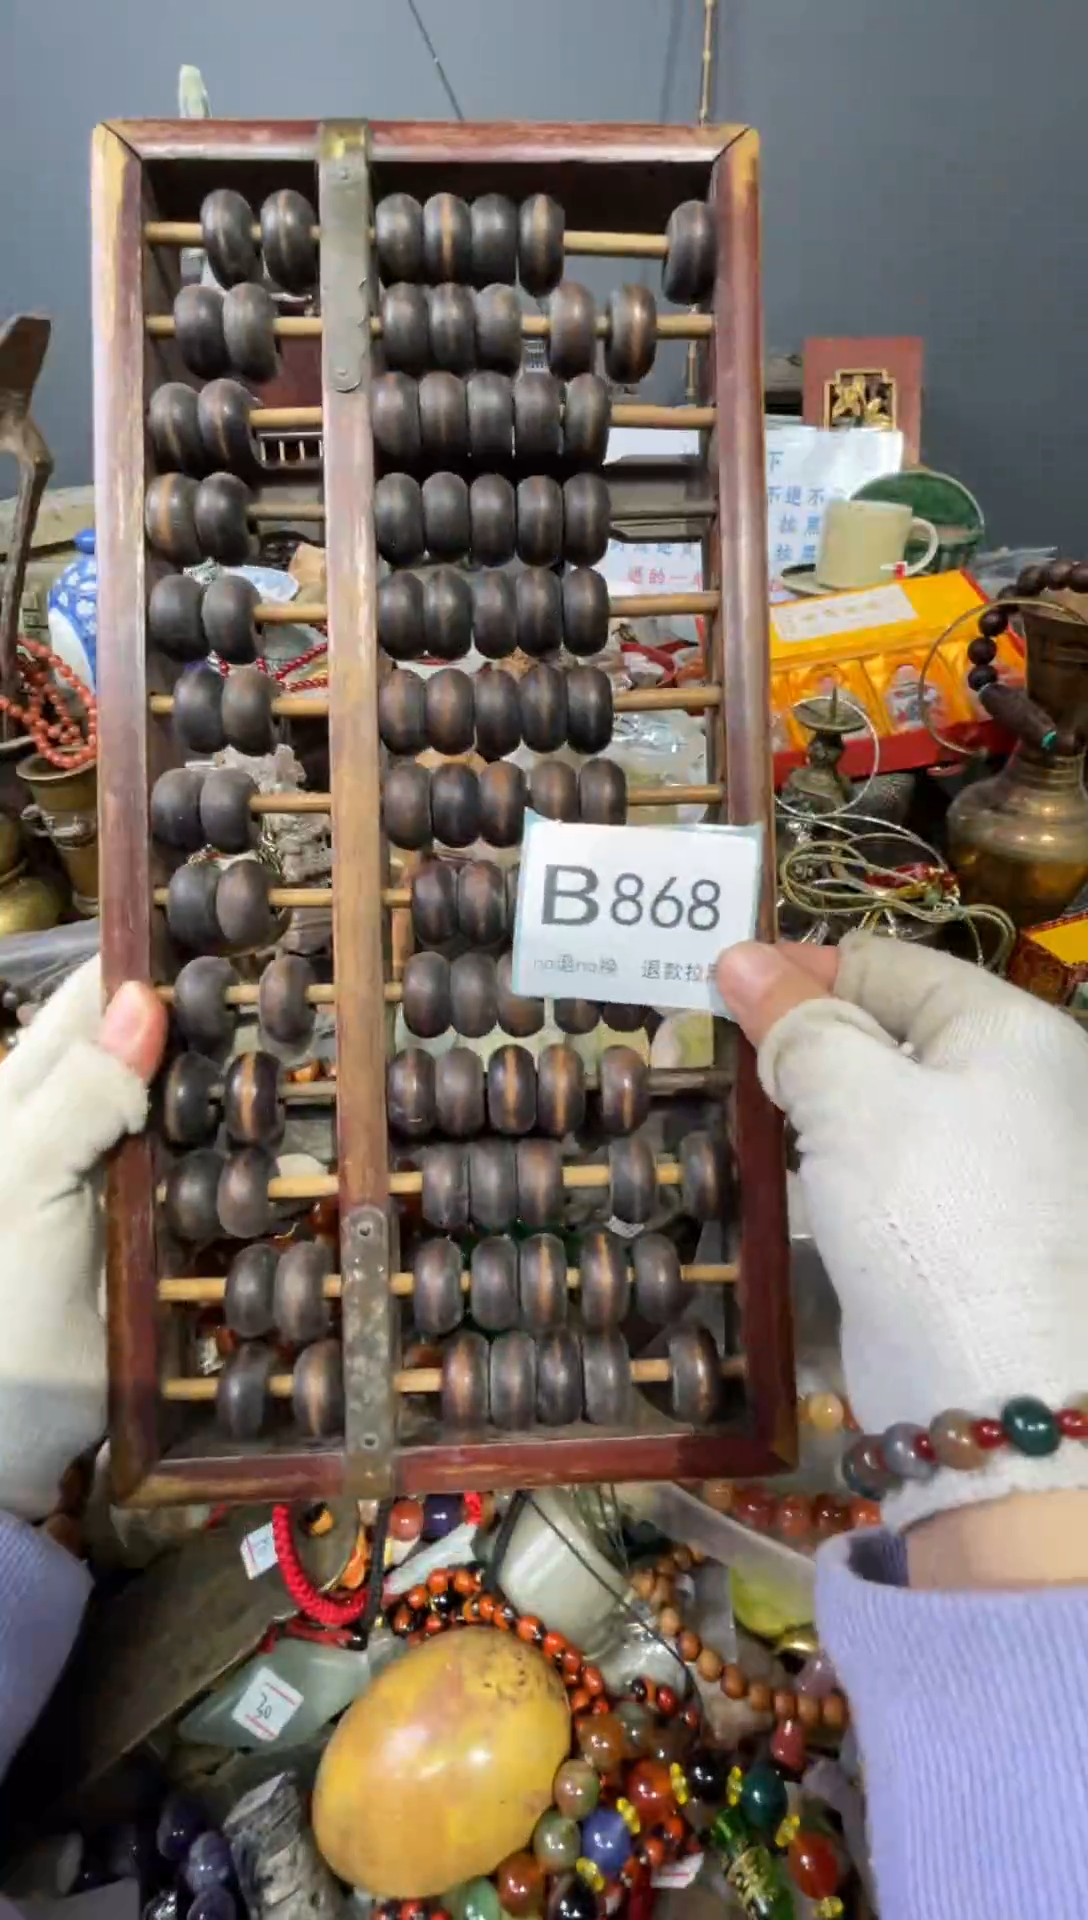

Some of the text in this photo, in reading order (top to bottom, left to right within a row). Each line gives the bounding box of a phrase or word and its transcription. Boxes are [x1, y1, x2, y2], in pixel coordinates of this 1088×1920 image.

[768, 485, 845, 507] 不退不
[541, 864, 721, 931] B868
